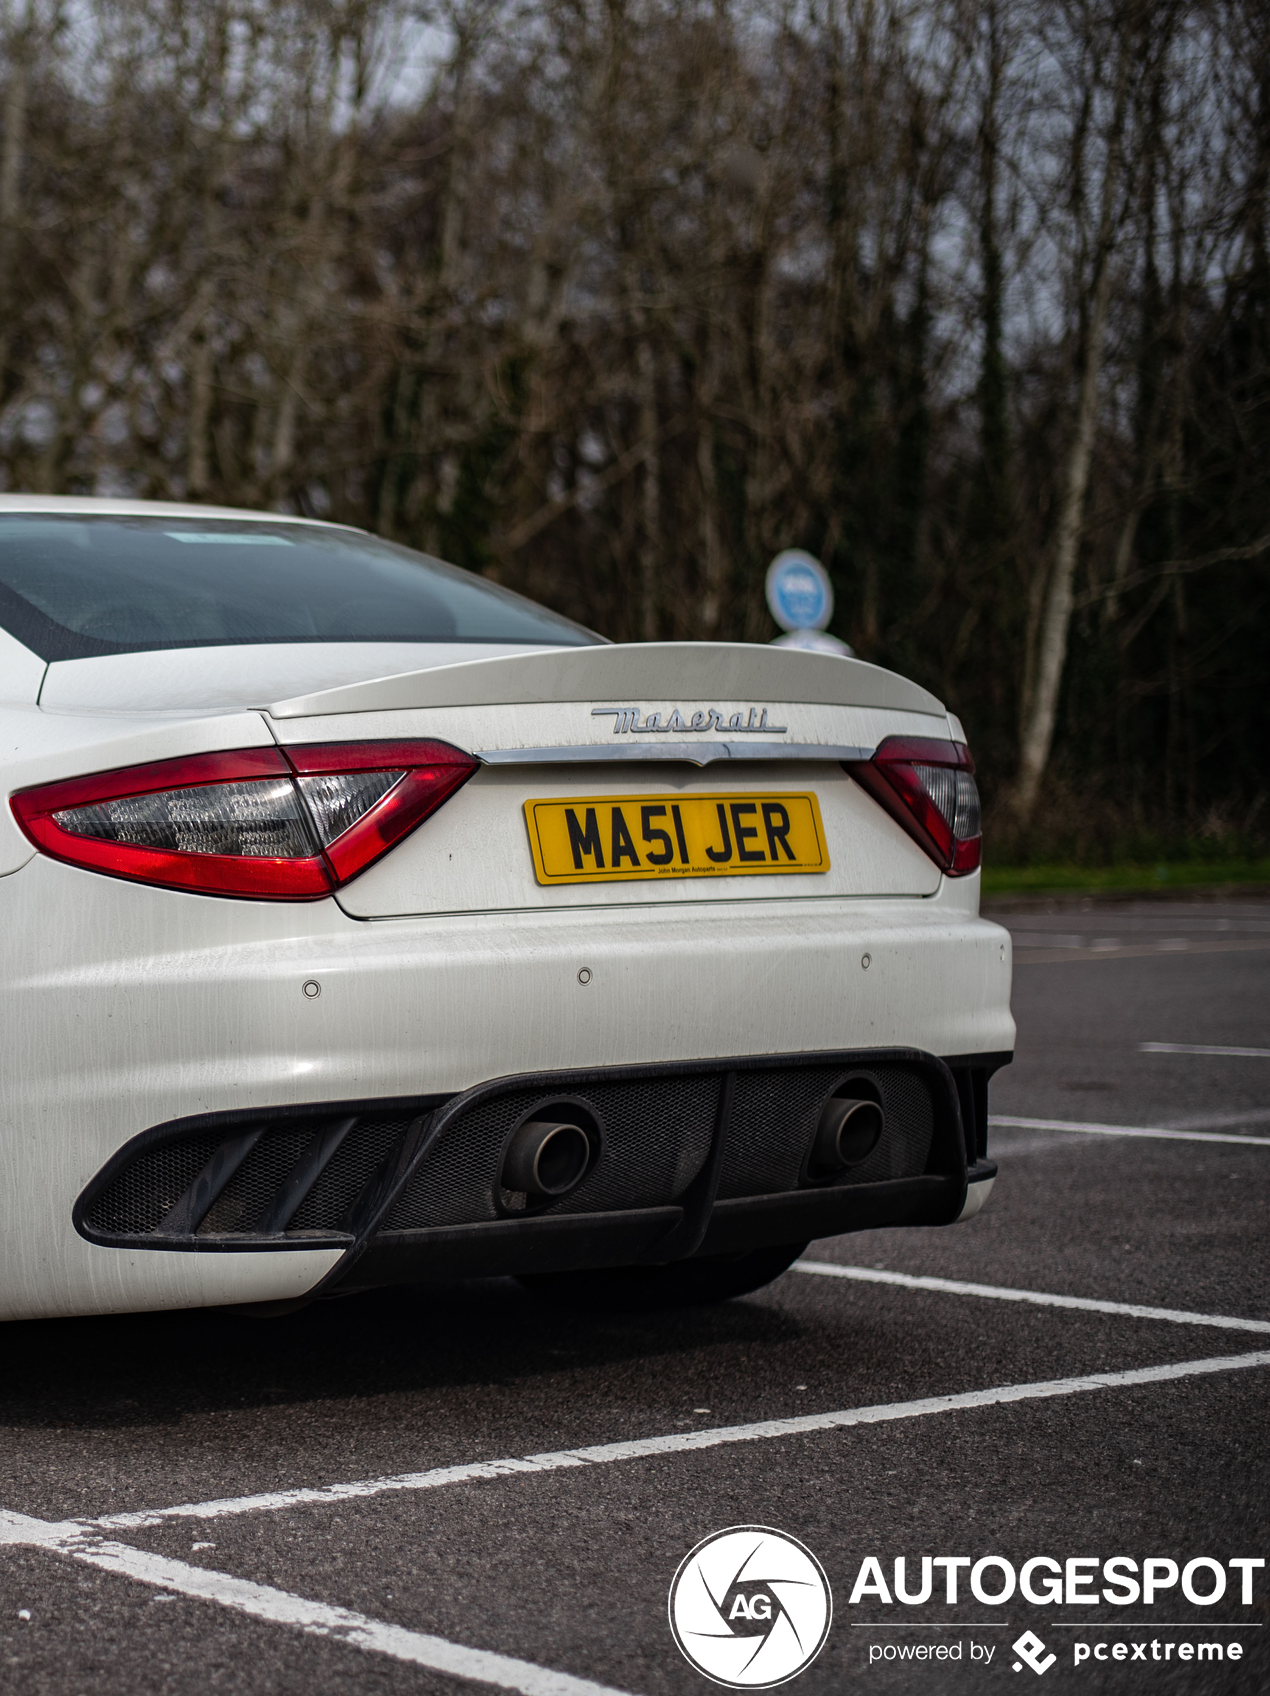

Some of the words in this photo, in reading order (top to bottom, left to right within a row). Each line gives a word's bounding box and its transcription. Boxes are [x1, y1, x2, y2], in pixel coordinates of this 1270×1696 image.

[591, 707, 788, 734] Maserati
[564, 804, 691, 870] MA51
[704, 802, 797, 863] JER
[671, 866, 690, 874] Morgan
